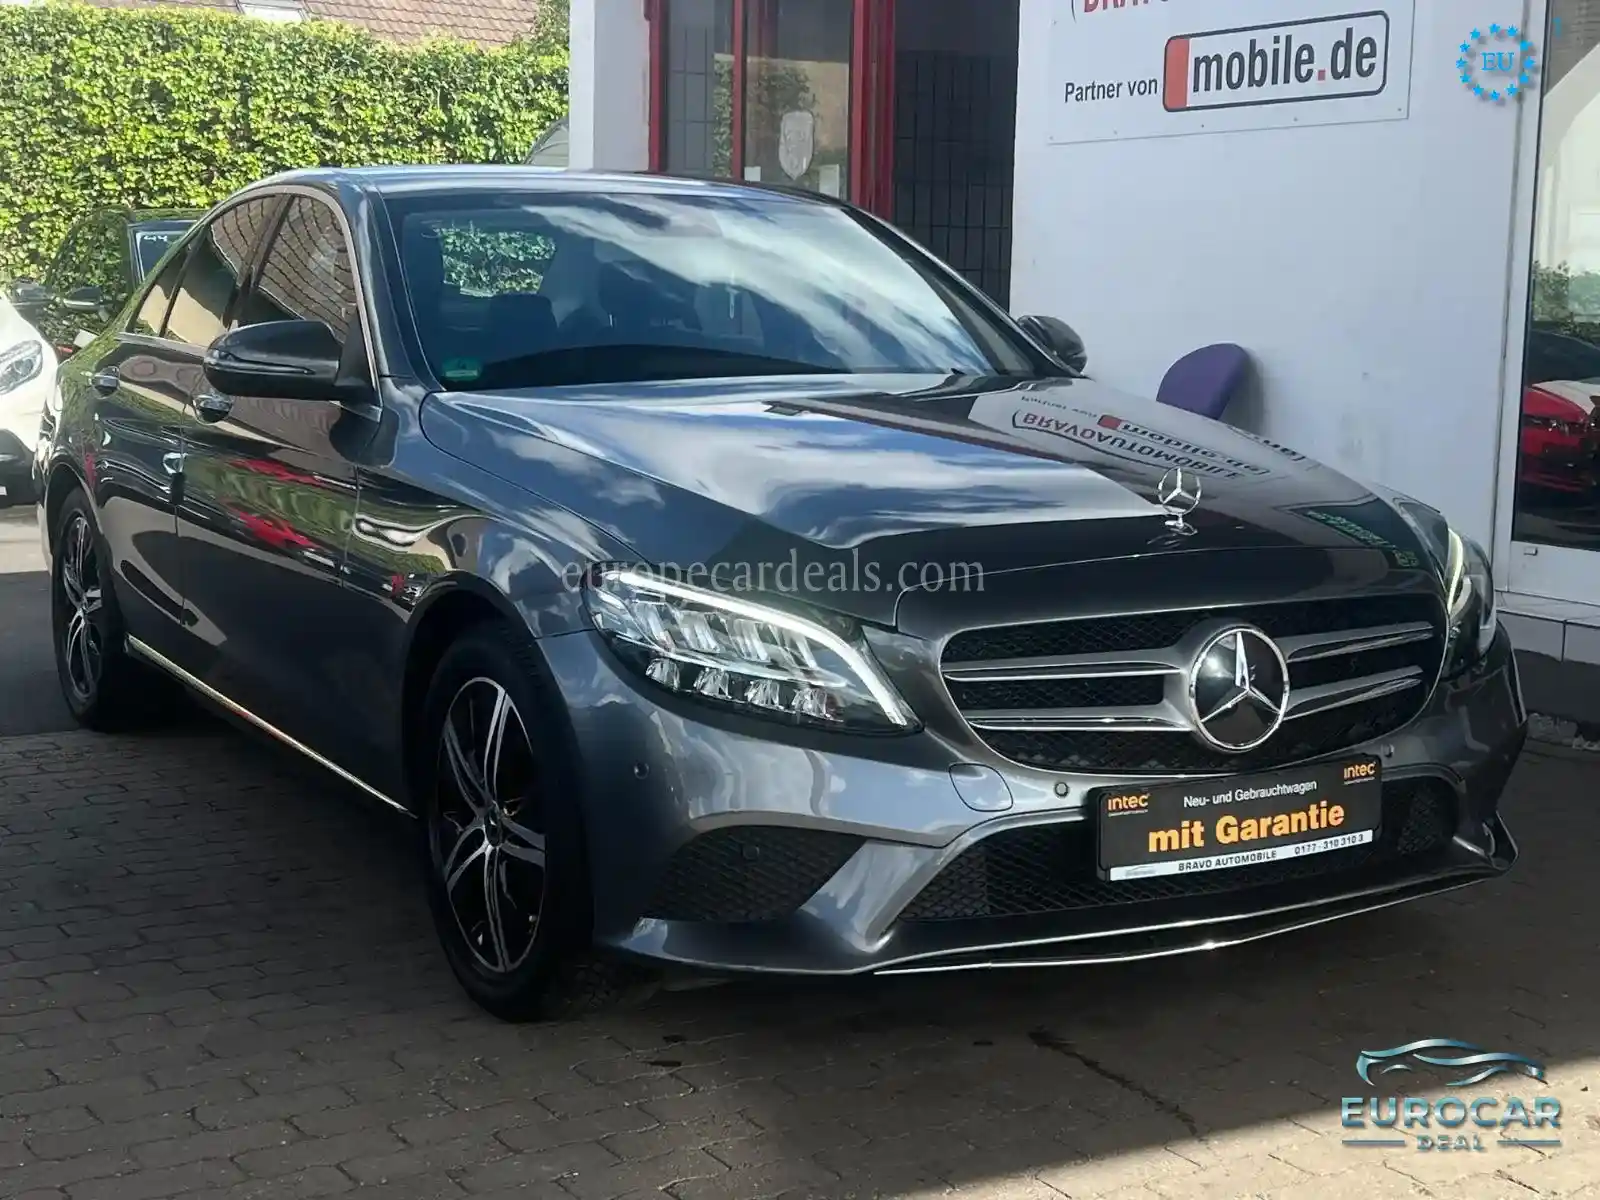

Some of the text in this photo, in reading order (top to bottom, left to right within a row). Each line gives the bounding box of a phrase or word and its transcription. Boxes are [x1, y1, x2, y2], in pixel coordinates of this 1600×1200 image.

[1064, 27, 1378, 103] Partner von mobile.de
[1343, 763, 1376, 779] intec
[1107, 794, 1149, 811] intec
[1183, 780, 1317, 809] Neu- und Gebrauchtwagen
[1148, 800, 1345, 853] mit Garantie
[1178, 859, 1212, 872] BRAVO
[1214, 850, 1277, 867] AUTOMOBILE
